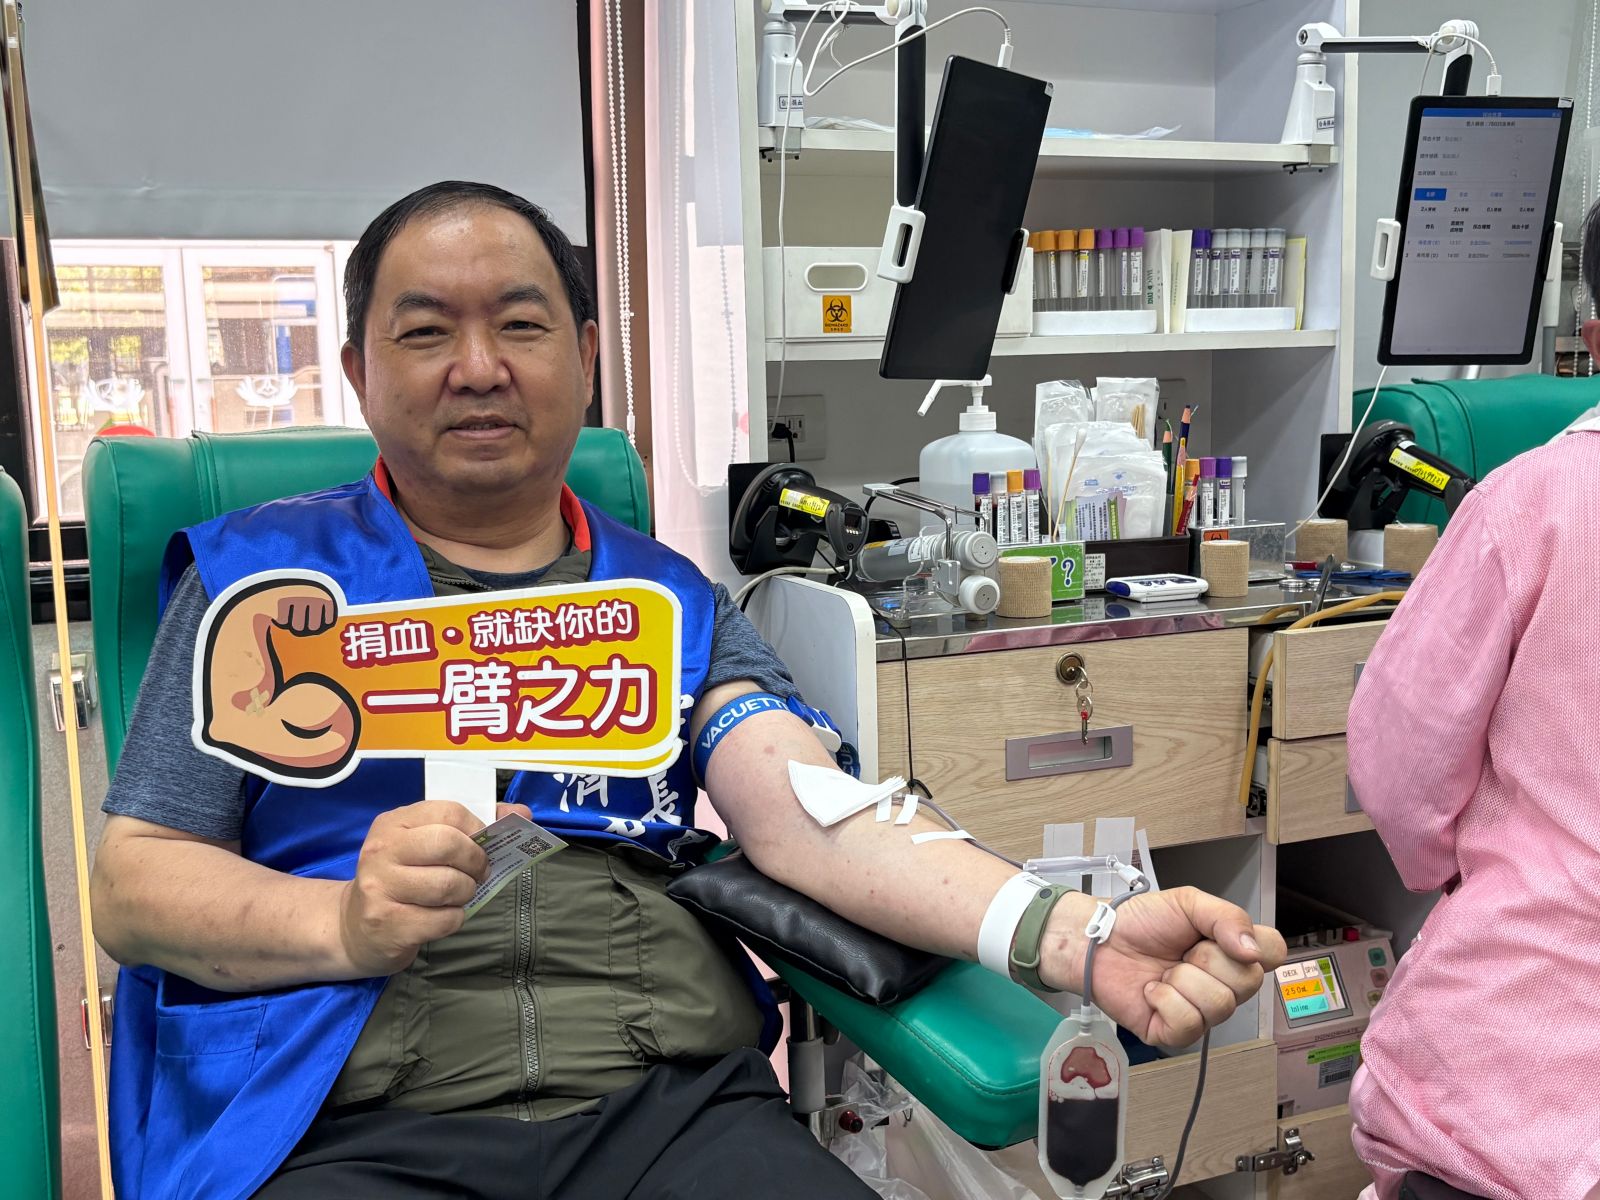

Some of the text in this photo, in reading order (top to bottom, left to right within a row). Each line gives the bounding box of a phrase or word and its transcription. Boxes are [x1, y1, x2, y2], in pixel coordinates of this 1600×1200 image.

[366, 659, 650, 736] 一臂之力
[702, 697, 789, 749] VACUETT
[1282, 968, 1298, 978] CHECK
